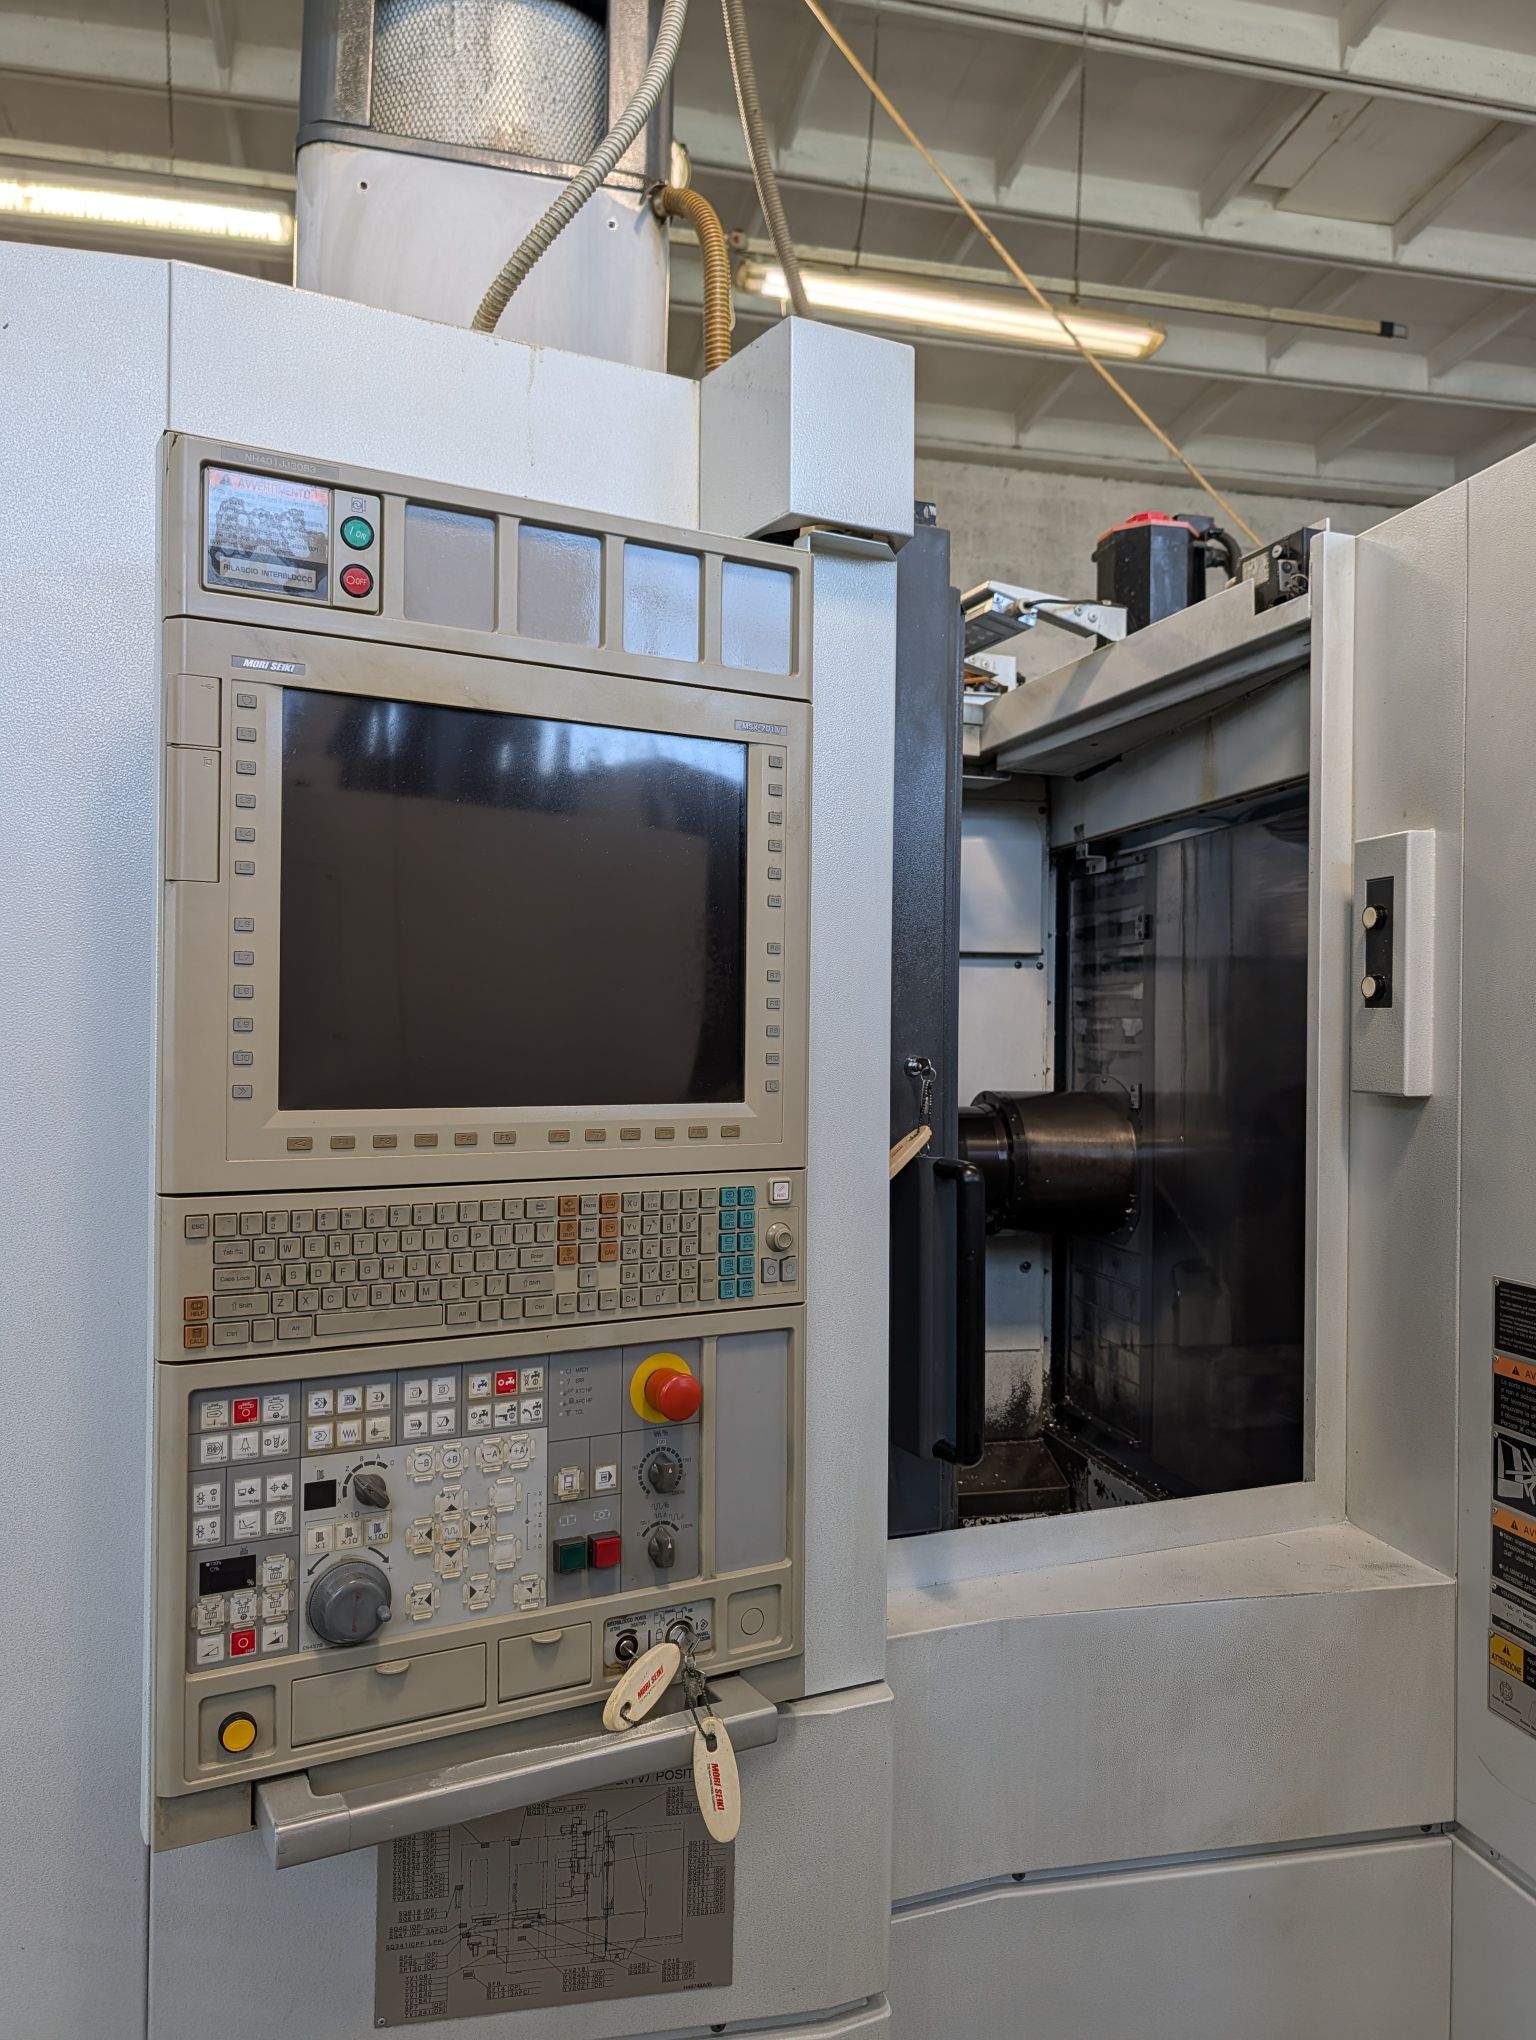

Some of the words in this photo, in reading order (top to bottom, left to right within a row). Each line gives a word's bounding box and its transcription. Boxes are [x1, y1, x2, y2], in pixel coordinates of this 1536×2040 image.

[356, 531, 367, 540] ON
[355, 578, 367, 586] OFF
[243, 659, 269, 670] MORI
[270, 662, 296, 673] SEIKI
[667, 1223, 672, 1231] 8
[407, 1237, 413, 1245] U
[475, 1233, 482, 1241] P
[334, 1242, 340, 1250] R
[359, 1240, 365, 1248] T
[382, 1238, 389, 1247] Y
[258, 1246, 266, 1255] Q
[283, 1244, 292, 1253] W
[310, 1243, 316, 1252] E
[412, 1263, 418, 1271] J
[435, 1261, 440, 1269] K
[458, 1259, 463, 1268] L
[340, 1267, 346, 1276] F
[364, 1266, 371, 1274] G
[388, 1264, 395, 1273] H
[265, 1273, 272, 1282] A
[290, 1271, 297, 1279] S
[315, 1269, 322, 1278] D
[376, 1291, 382, 1300] B
[400, 1289, 406, 1297] N
[423, 1287, 430, 1296] M
[302, 1297, 310, 1305] X
[327, 1295, 334, 1303] C
[352, 1293, 358, 1302] V
[277, 1299, 284, 1307] Z
[1492, 1653, 1522, 1676] ATTENZIONE
[638, 1680, 651, 1699] MORI
[711, 1764, 722, 1786] MORI
[715, 1788, 725, 1810] SEIKI
